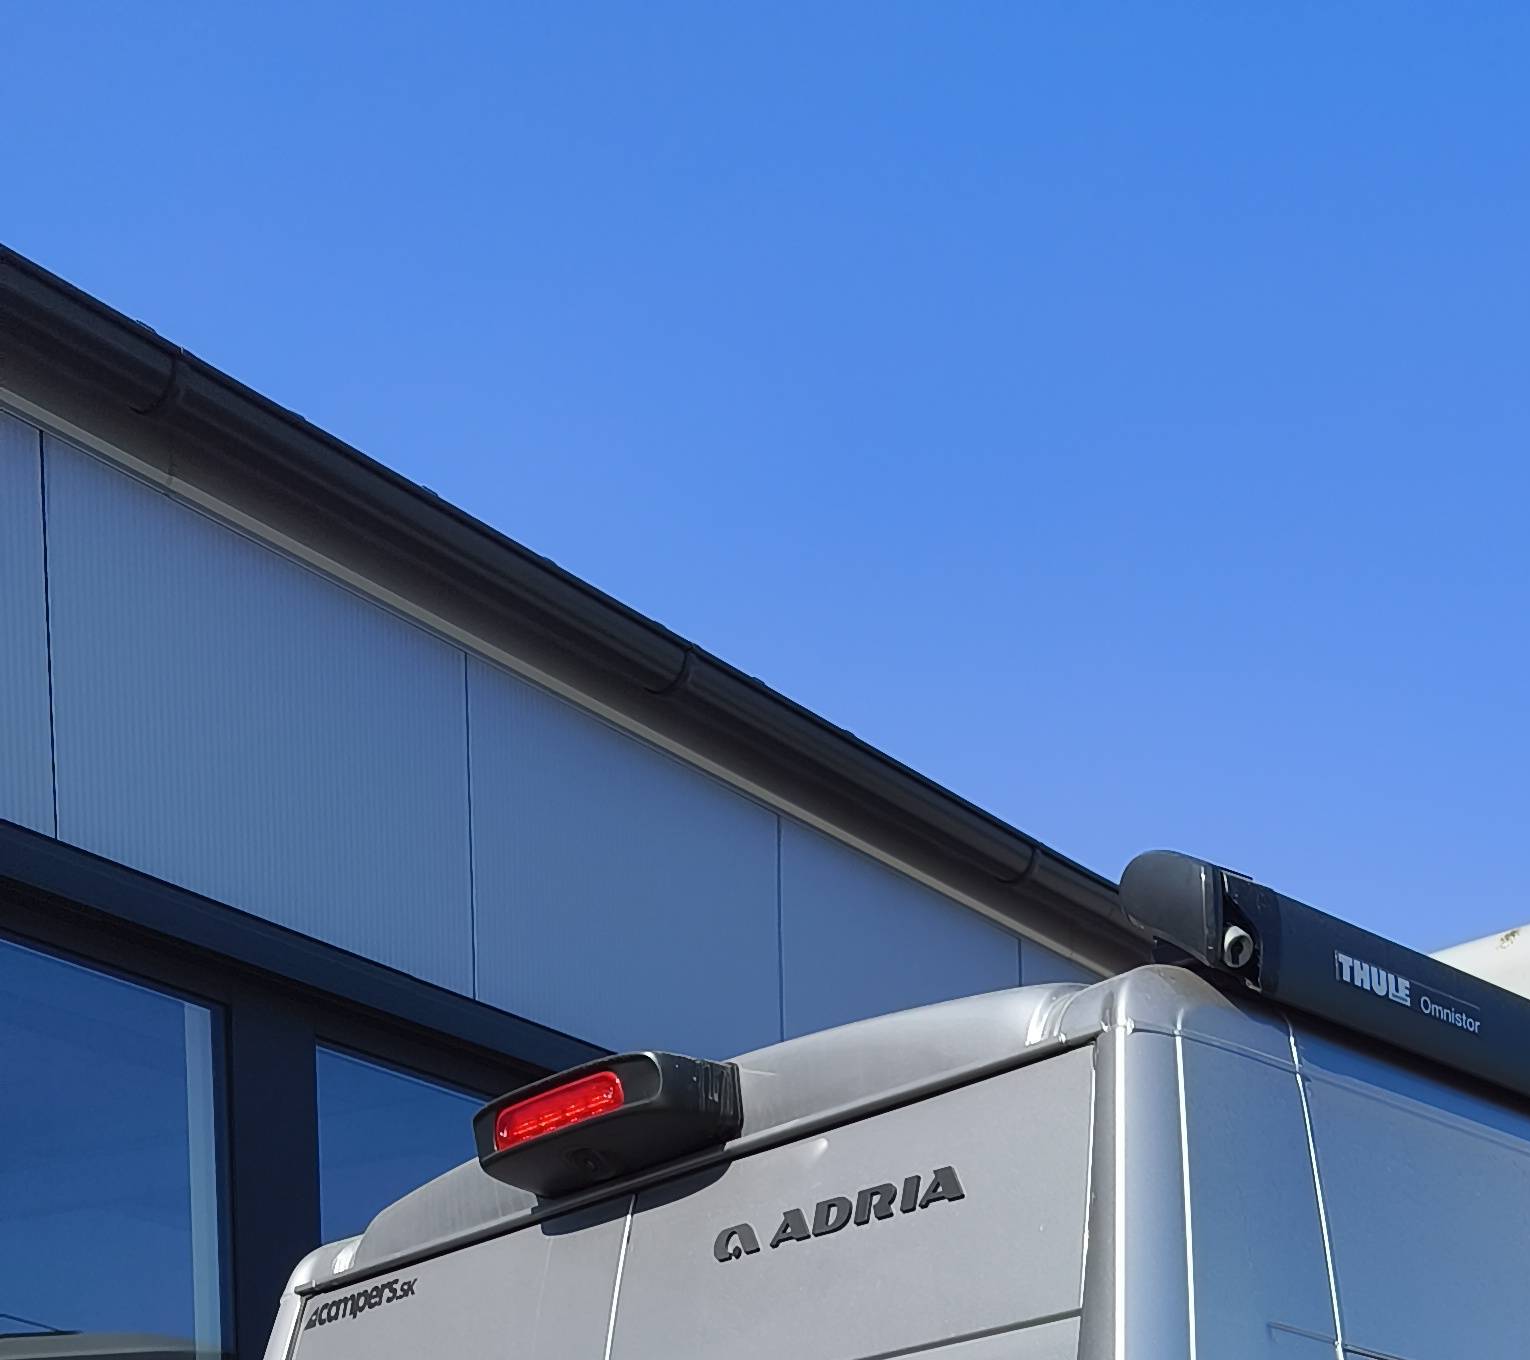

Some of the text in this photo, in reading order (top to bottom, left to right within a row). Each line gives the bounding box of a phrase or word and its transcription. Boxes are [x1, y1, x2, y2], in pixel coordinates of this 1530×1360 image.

[1338, 953, 1481, 1034] THULE Omnistor
[769, 1165, 966, 1249] ADRIA
